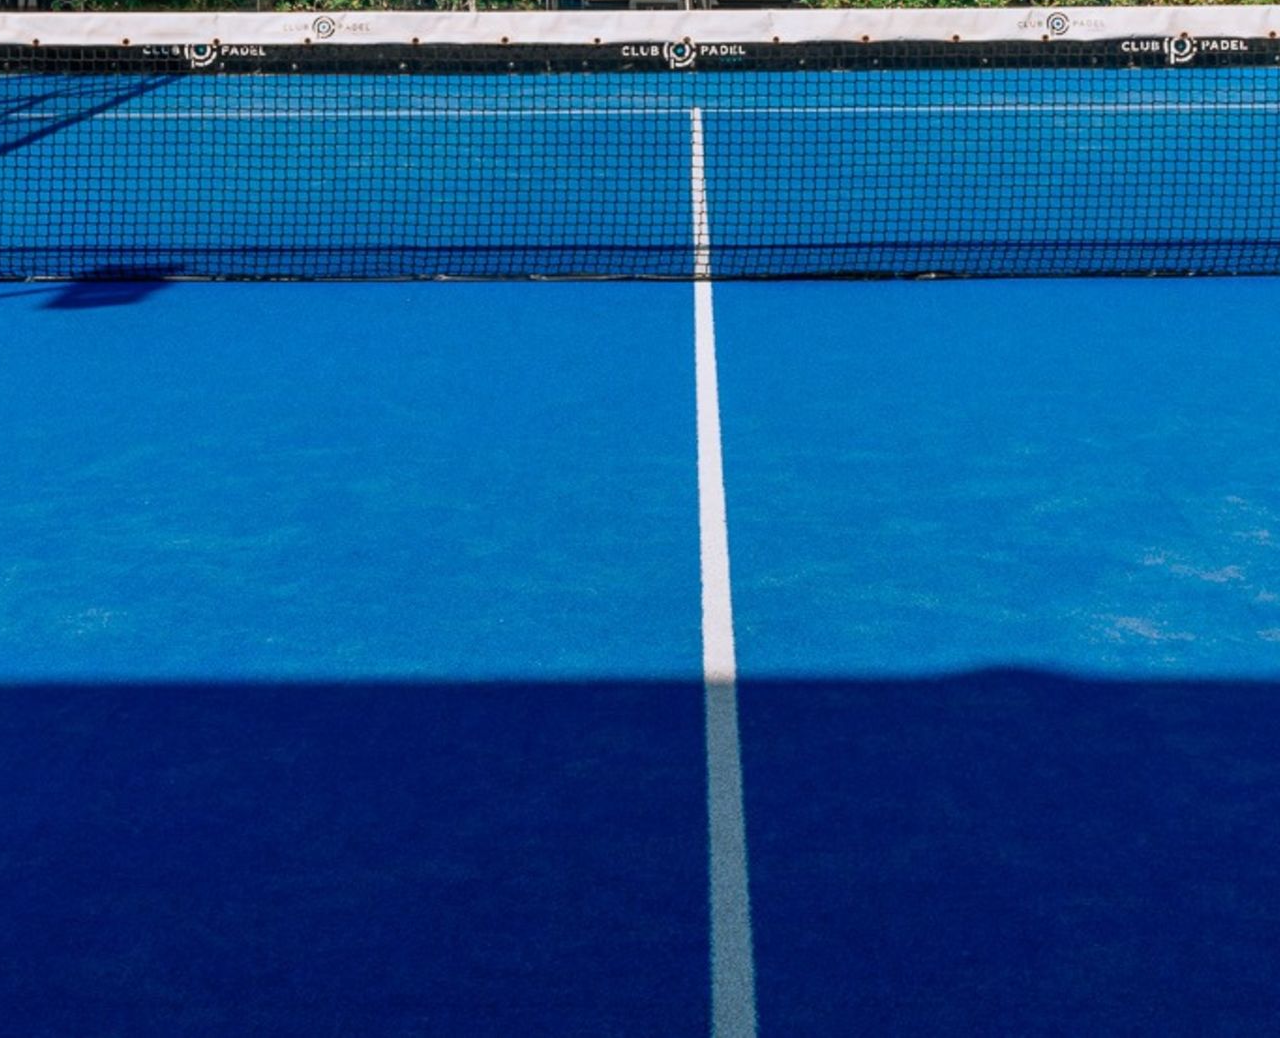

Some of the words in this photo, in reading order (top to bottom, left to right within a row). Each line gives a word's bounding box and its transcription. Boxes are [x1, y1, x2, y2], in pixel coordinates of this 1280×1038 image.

[622, 45, 660, 56] CLUB
[701, 45, 746, 55] PADEL
[1121, 42, 1160, 52] CLUB
[1201, 40, 1248, 51] PADEL
